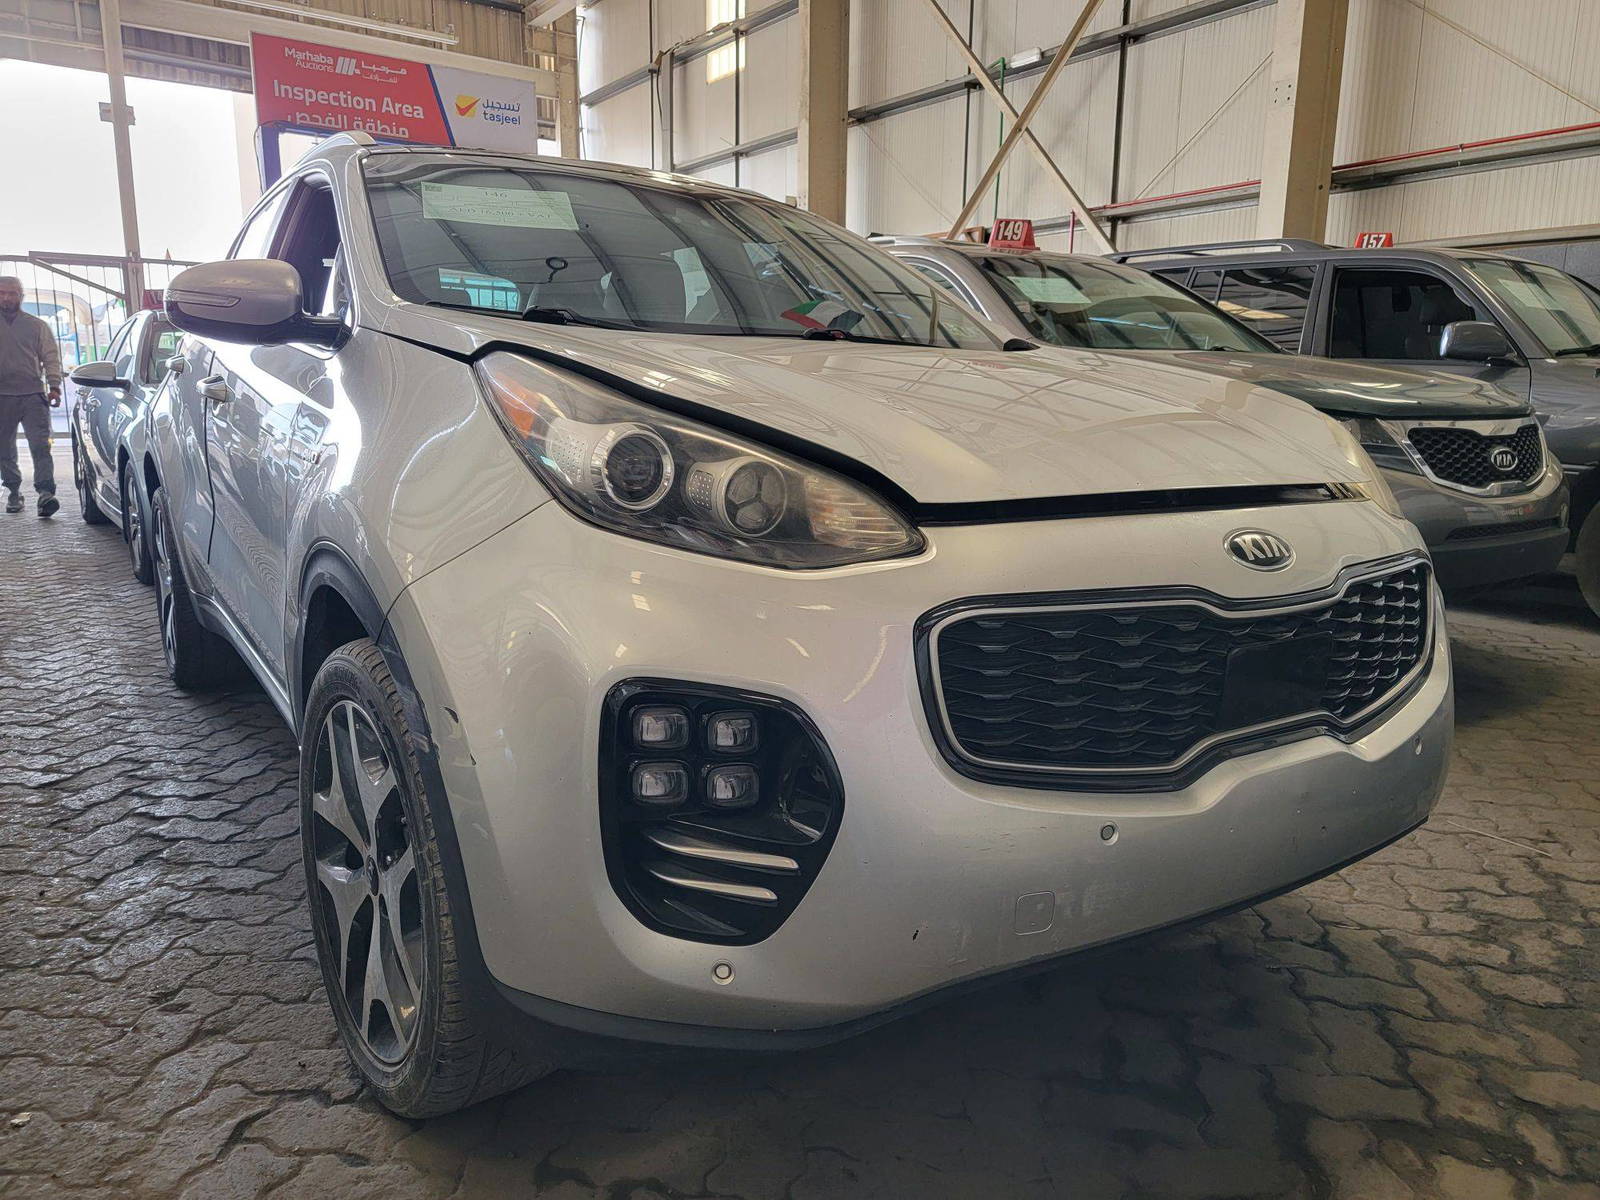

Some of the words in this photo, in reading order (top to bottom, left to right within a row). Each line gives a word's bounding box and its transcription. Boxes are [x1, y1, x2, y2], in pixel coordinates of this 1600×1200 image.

[284, 47, 333, 65] Marhaba
[295, 59, 334, 73] Auctions
[361, 60, 407, 76] مرحبا
[273, 79, 376, 111] Inspection
[382, 97, 424, 119] Area
[482, 99, 520, 112] تسجيل
[482, 110, 521, 126] tasjeel
[353, 116, 409, 139] منطقة
[997, 220, 1024, 241] 149
[1361, 233, 1386, 249] 157
[1495, 454, 1513, 466] KIA
[1233, 533, 1290, 561] KIA
